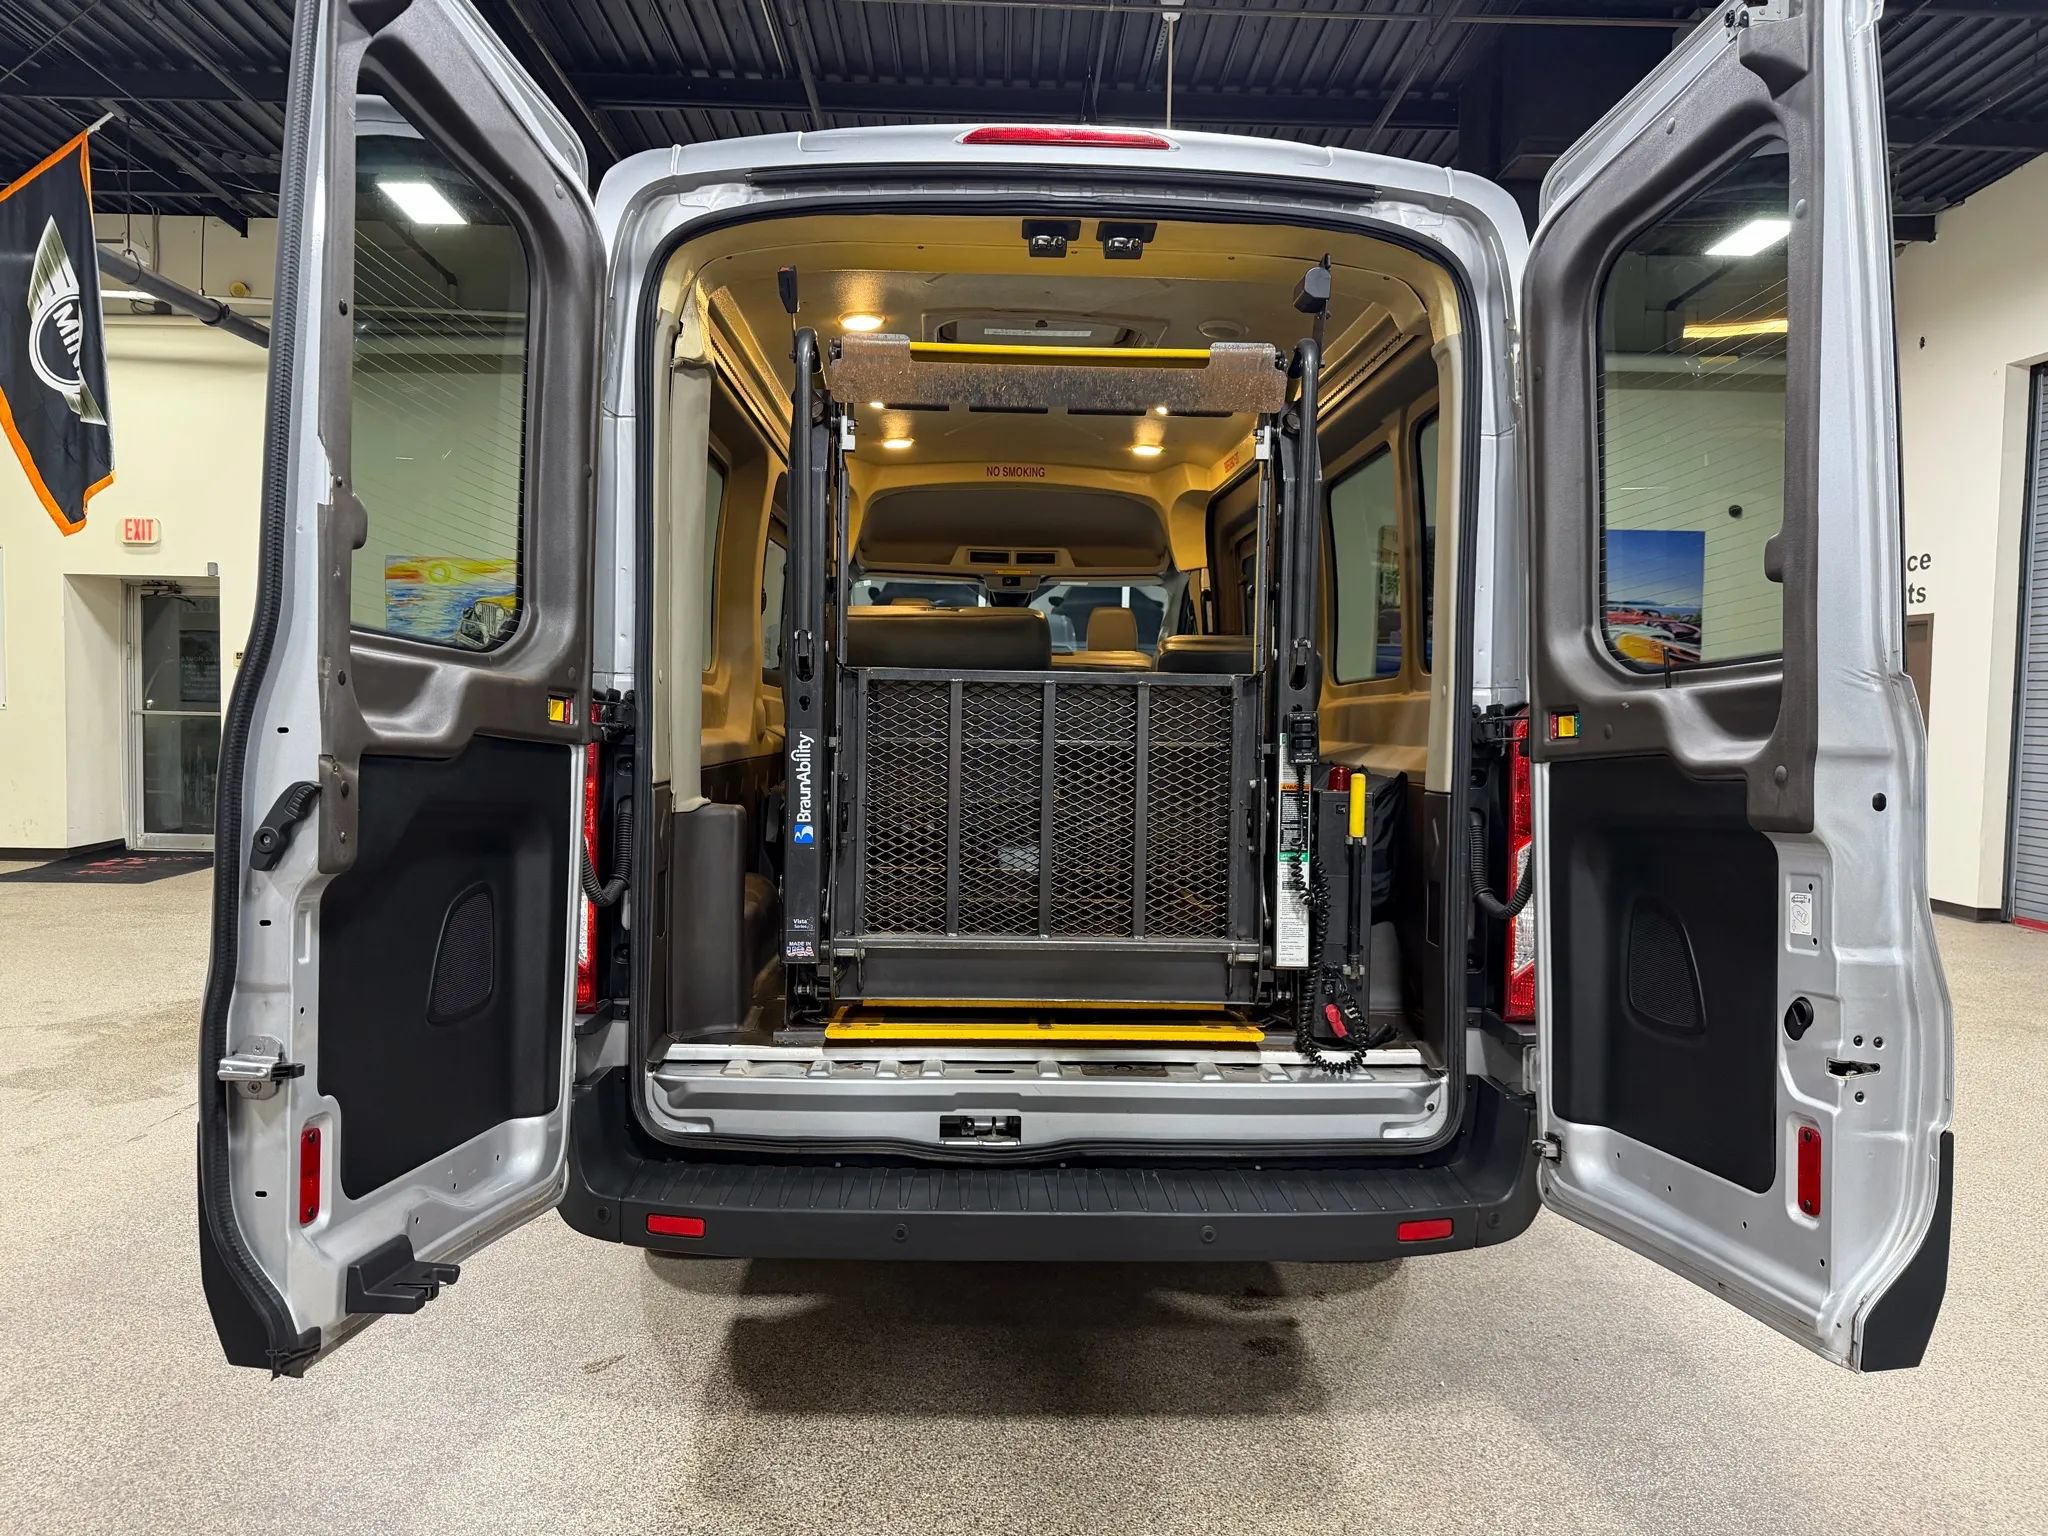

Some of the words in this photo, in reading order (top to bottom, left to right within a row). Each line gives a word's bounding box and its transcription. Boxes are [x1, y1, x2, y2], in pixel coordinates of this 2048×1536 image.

[52, 302, 80, 379] MIN
[986, 466, 1000, 477] NO
[1002, 466, 1045, 478] SMOKING
[124, 518, 154, 541] EXIT
[790, 733, 815, 823] BraunAbility
